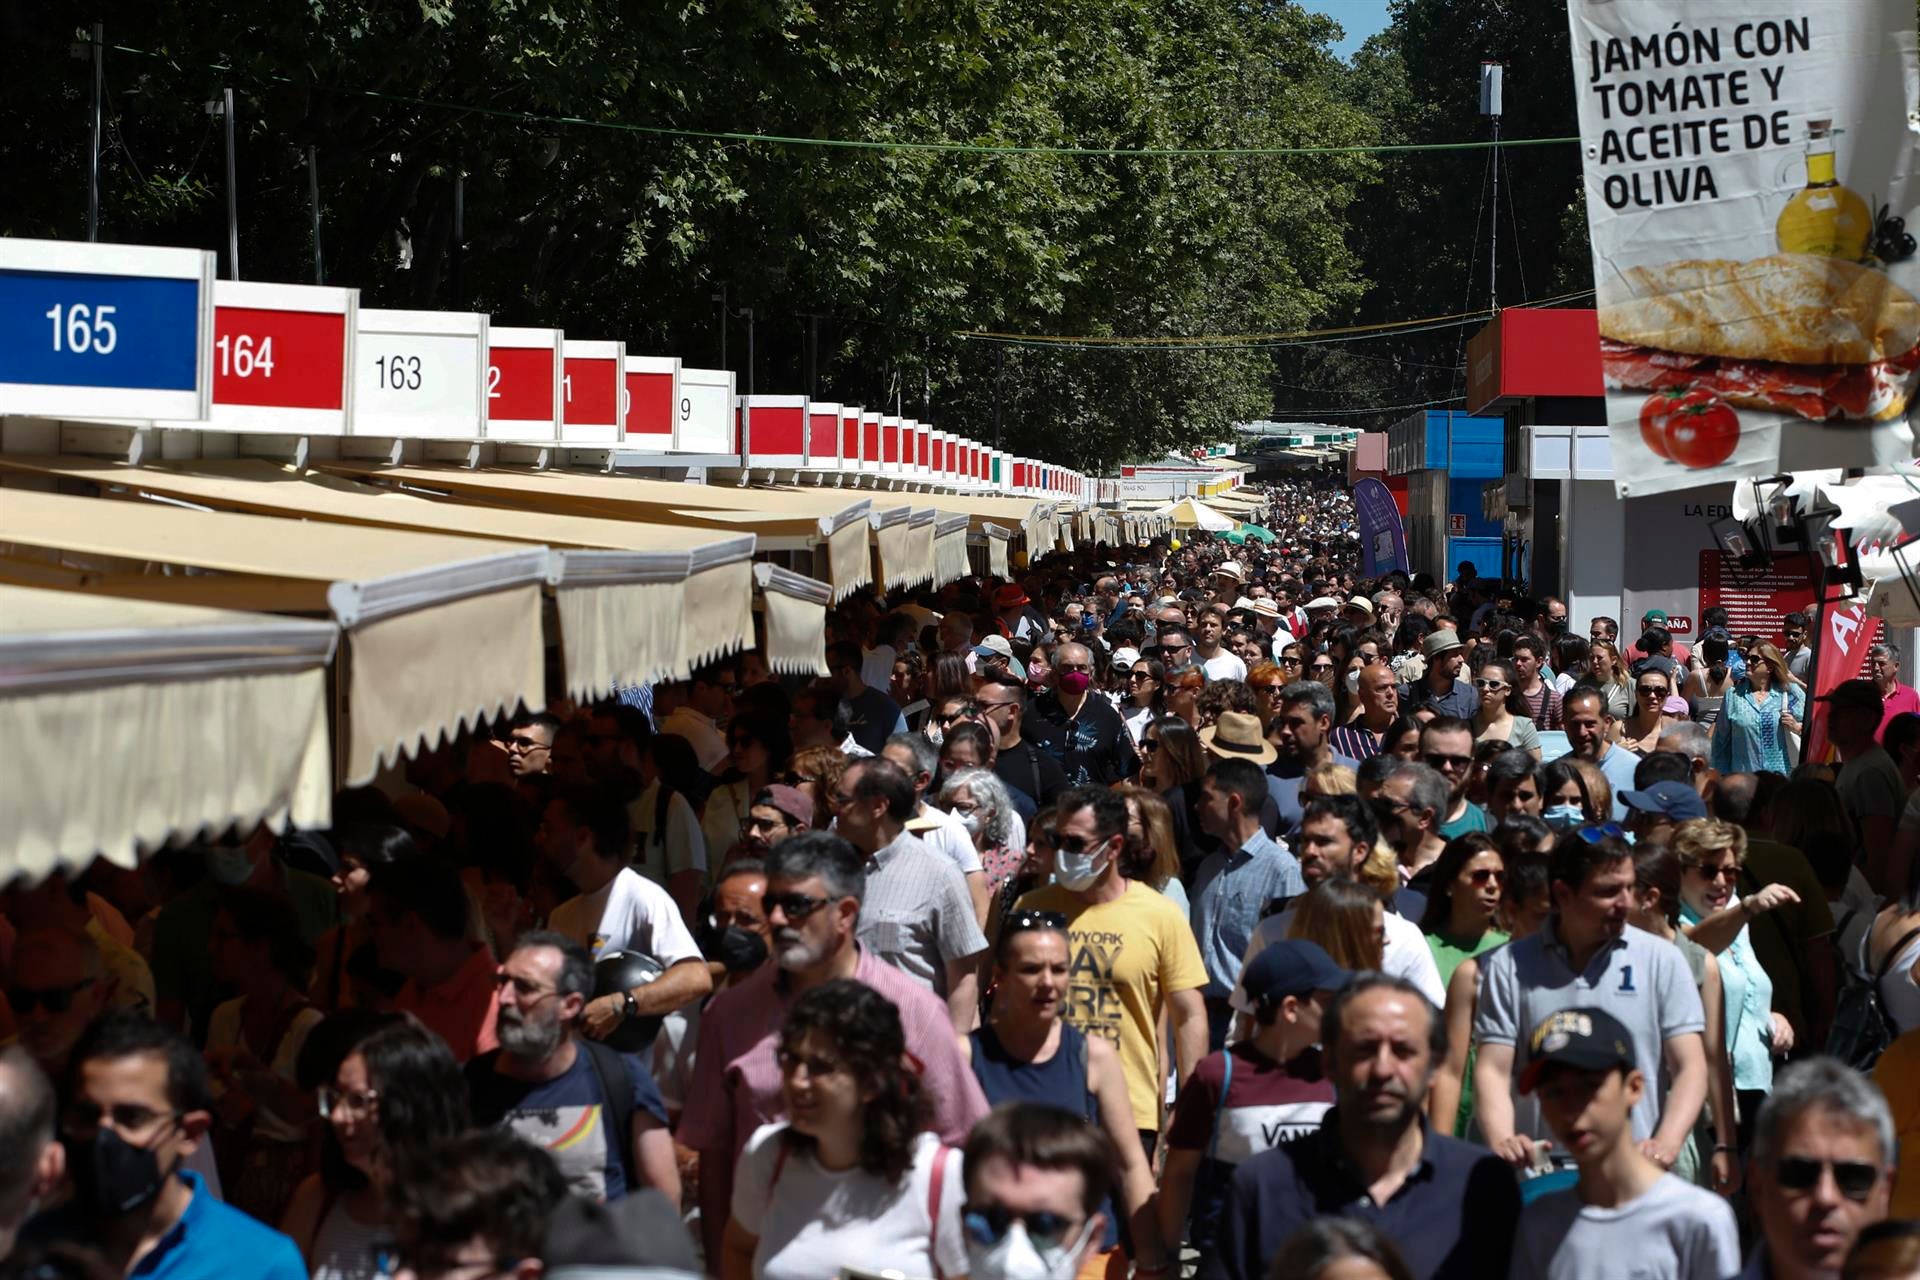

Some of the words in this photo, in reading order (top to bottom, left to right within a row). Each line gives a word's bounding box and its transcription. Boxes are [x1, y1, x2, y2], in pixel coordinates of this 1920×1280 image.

[1590, 22, 1720, 82] JAMÓN
[1734, 17, 1810, 60] CON
[1593, 70, 1749, 119] TOMATE
[1761, 66, 1784, 100] Y
[1600, 118, 1730, 165] ACEITE
[1743, 110, 1790, 150] DE
[1603, 165, 1719, 209] OLIVA
[46, 303, 117, 354] 165
[216, 335, 274, 377] 164
[375, 355, 422, 390] 163
[1684, 504, 1703, 516] LA
[1667, 617, 1688, 629] AÑA
[1069, 931, 1123, 945] WYORK
[1070, 945, 1123, 979] AY
[1619, 965, 1635, 991] 1
